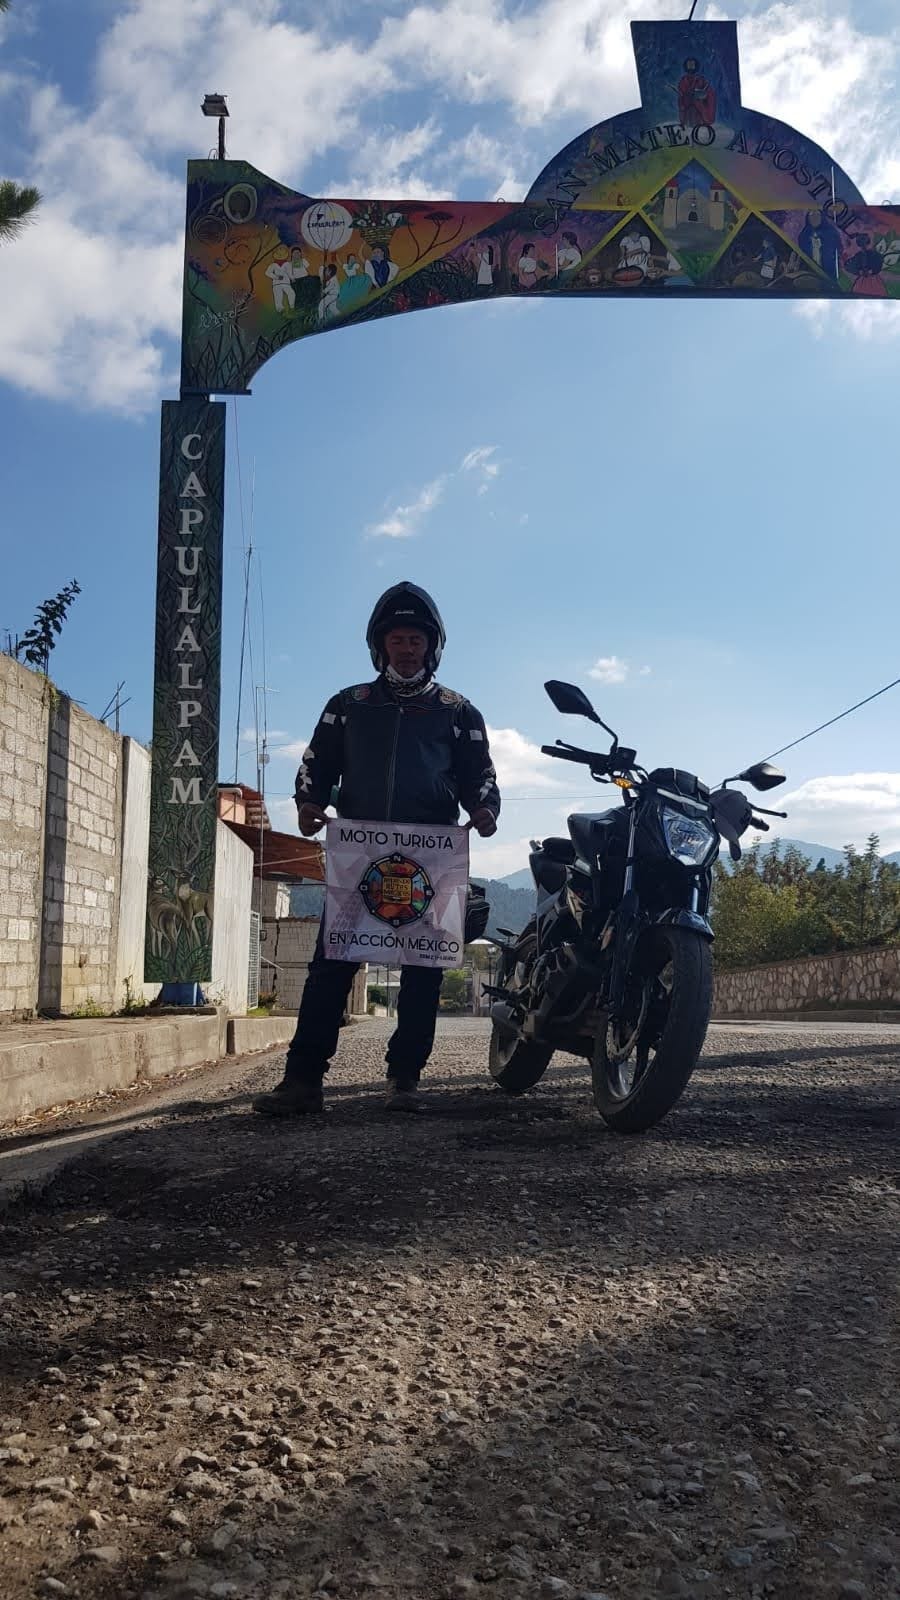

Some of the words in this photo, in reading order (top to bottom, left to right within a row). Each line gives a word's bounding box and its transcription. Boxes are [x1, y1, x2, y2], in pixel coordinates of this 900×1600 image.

[531, 170, 587, 236] SAN
[588, 123, 716, 176] MATEO
[168, 432, 206, 805] CAPULÁLPAM
[340, 828, 388, 845] MOTO
[393, 833, 453, 849] TURISTA
[329, 933, 348, 945] EN
[349, 932, 404, 949] ACCIÓN
[408, 936, 459, 953] MÉXICO
